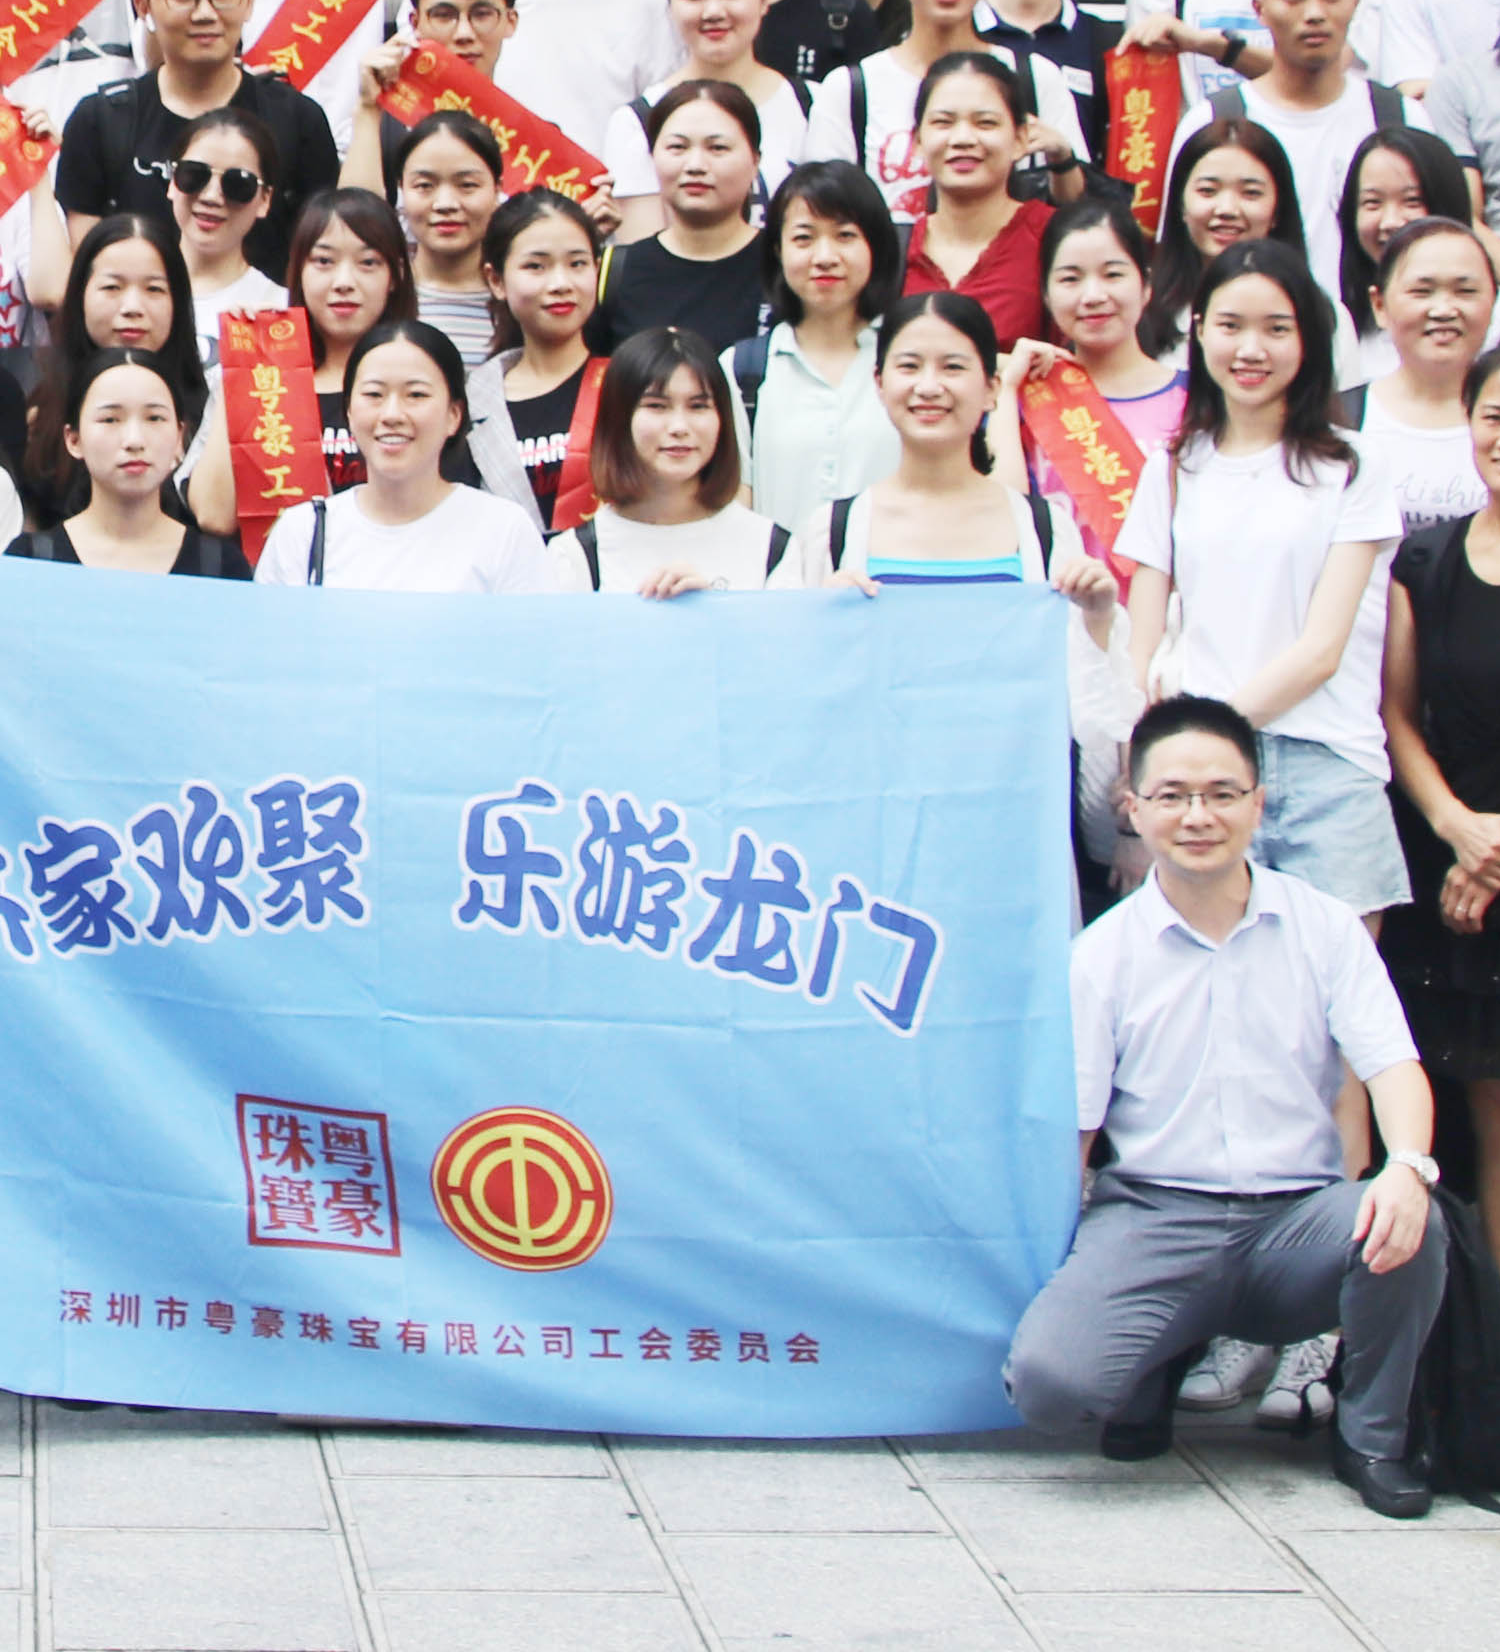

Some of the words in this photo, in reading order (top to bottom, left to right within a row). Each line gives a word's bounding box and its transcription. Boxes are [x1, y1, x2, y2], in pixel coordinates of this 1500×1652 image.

[1119, 86, 1159, 228] 粤豪工
[248, 362, 305, 526] 粤豪工
[453, 778, 944, 1036] 乐游龙门
[59, 1287, 822, 1366] 深圳市粤豪珠宝有限公司工会委员会
